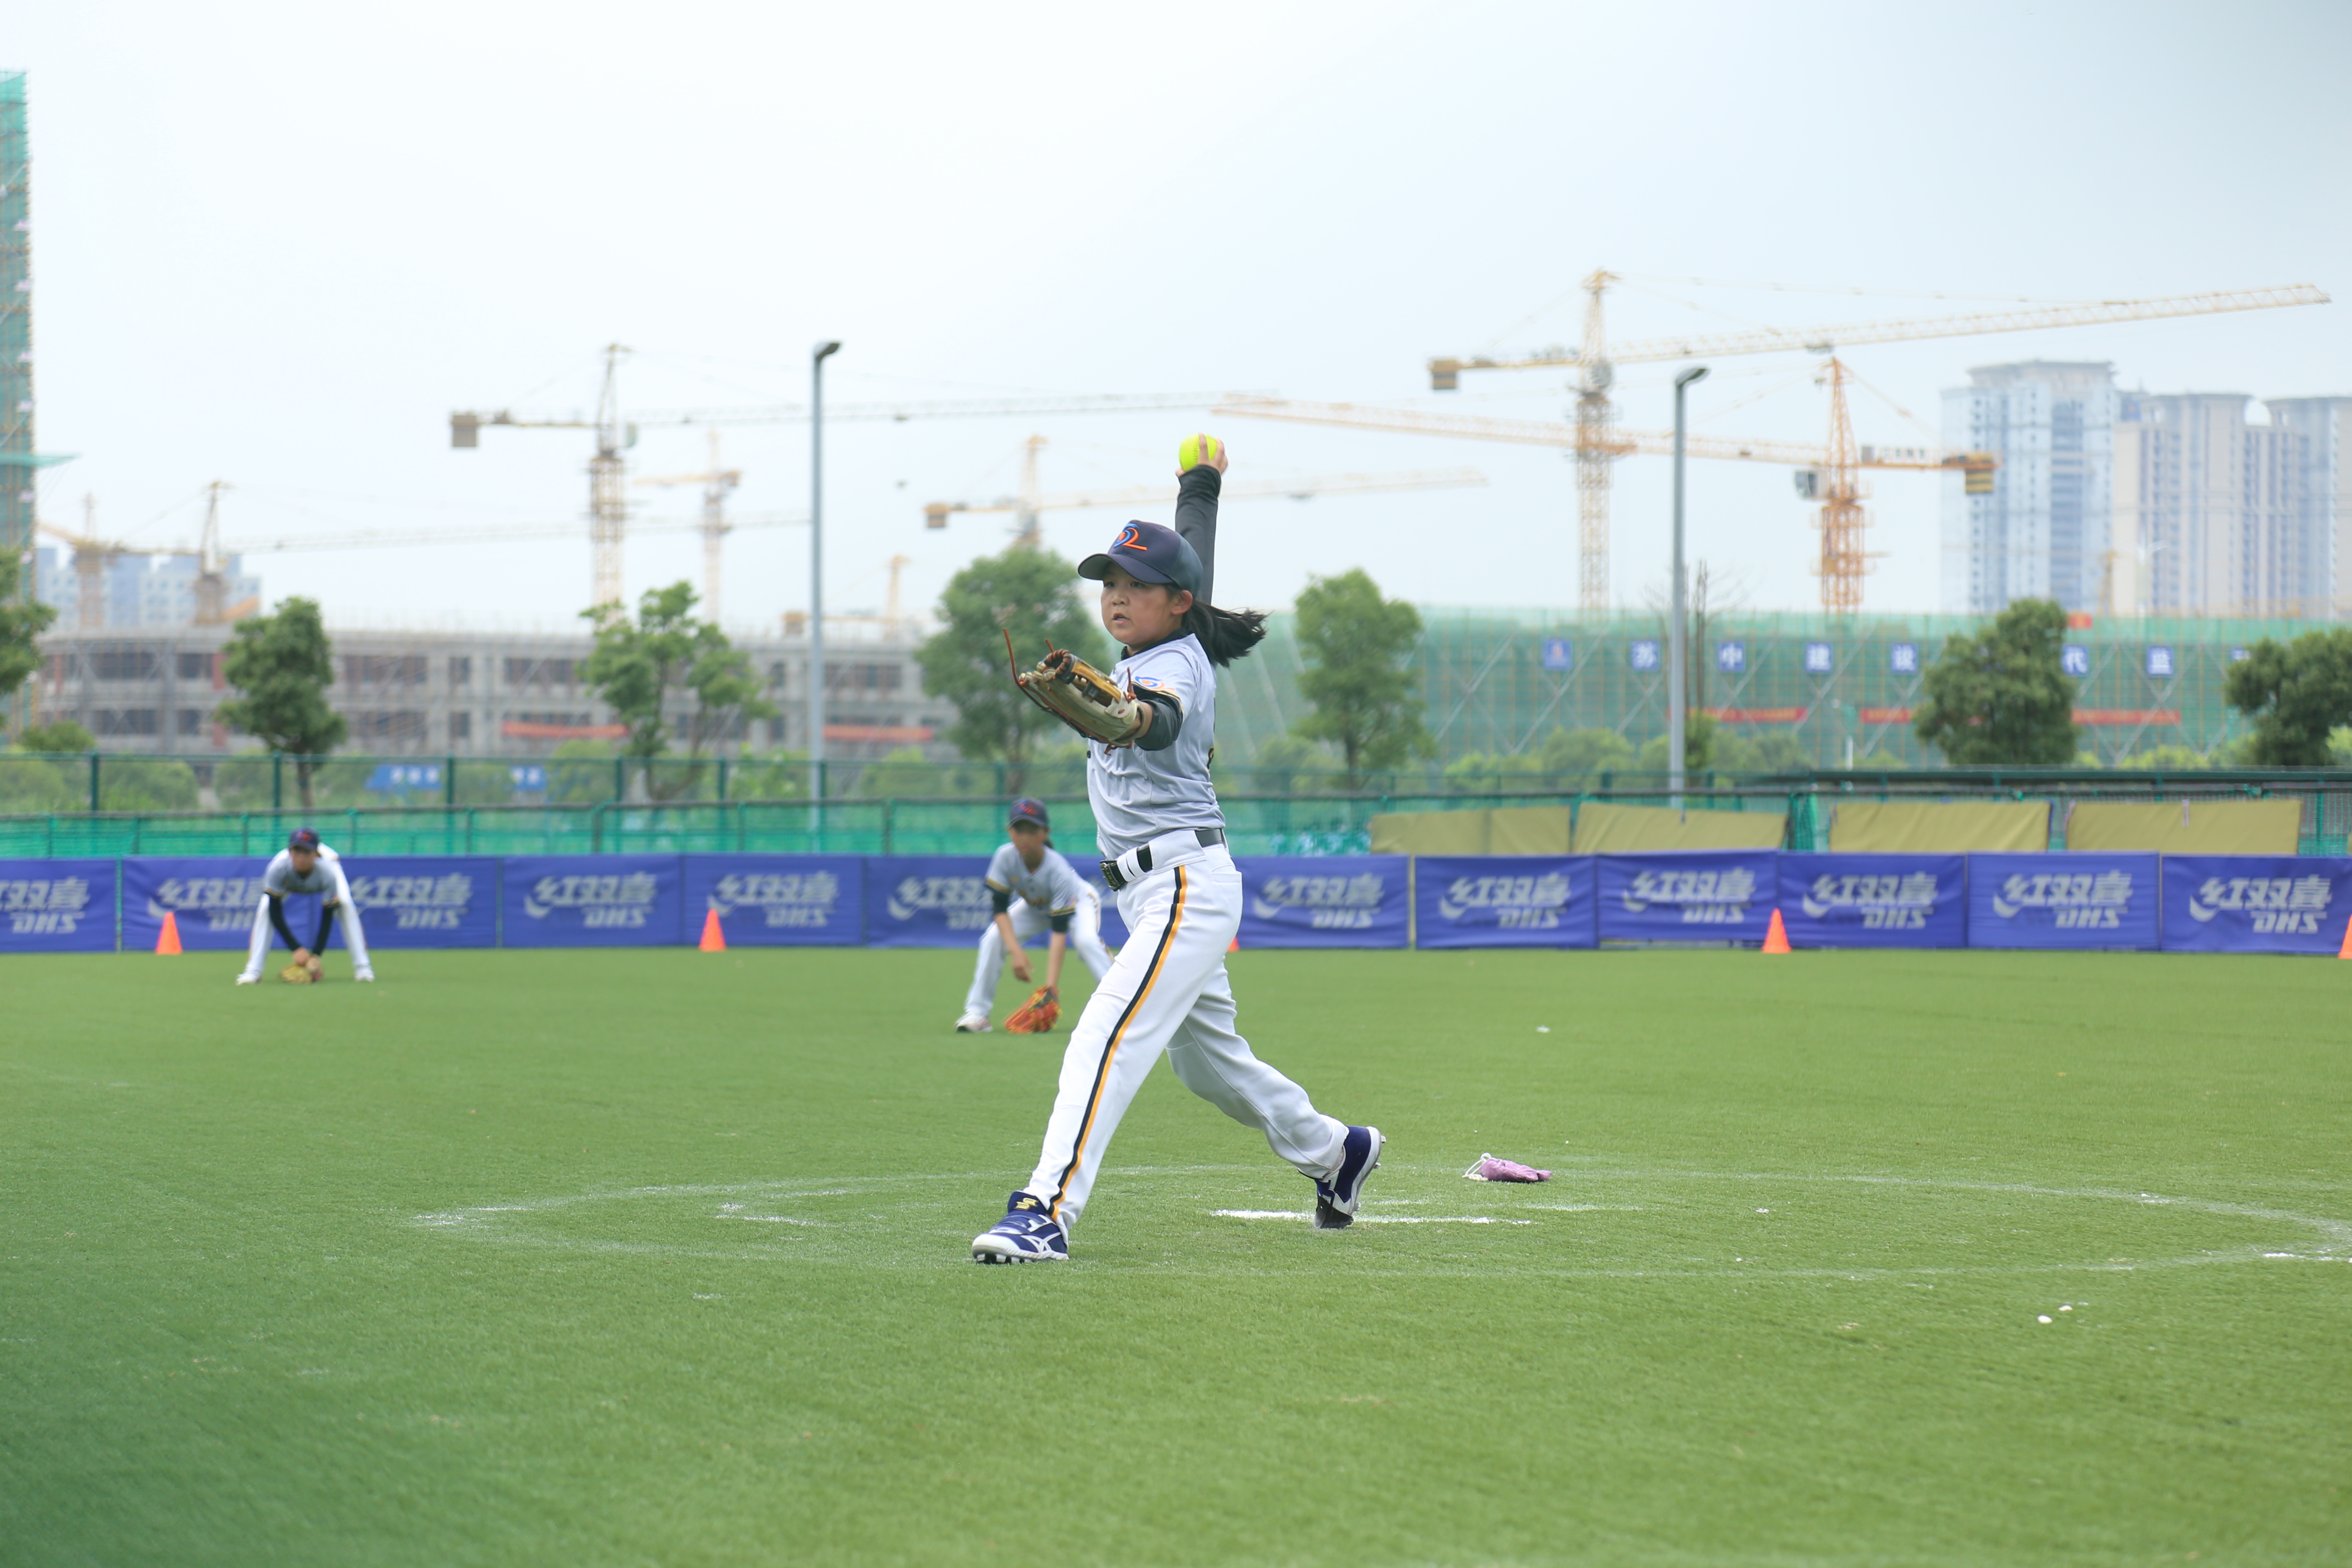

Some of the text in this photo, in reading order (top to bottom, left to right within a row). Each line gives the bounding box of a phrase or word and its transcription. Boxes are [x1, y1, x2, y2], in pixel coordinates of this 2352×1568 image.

[0, 876, 90, 911] 双喜
[158, 878, 266, 910] 红双
[350, 873, 472, 908] 红双喜
[534, 871, 658, 906] 红双喜
[715, 871, 839, 906] 红双喜
[896, 876, 991, 909] 红双
[1262, 873, 1384, 906] 红双喜
[1448, 872, 1571, 908] 红双喜
[1631, 867, 1757, 903] 红双喜
[1813, 871, 1938, 907] 红双喜
[2002, 870, 2133, 906] 红双喜
[2199, 874, 2332, 910] 红双喜
[11, 911, 85, 934] DHS
[207, 910, 257, 931] DH
[395, 907, 470, 929] DHS
[580, 906, 653, 928] DHS
[764, 906, 834, 928] DHS
[944, 907, 992, 930] DH
[1311, 907, 1381, 929] DHS
[1494, 907, 1567, 929] DHS
[1682, 902, 1752, 924] DHS
[1860, 906, 1933, 929] DHS
[2053, 906, 2128, 929] DHS
[2250, 911, 2327, 934] DHS
